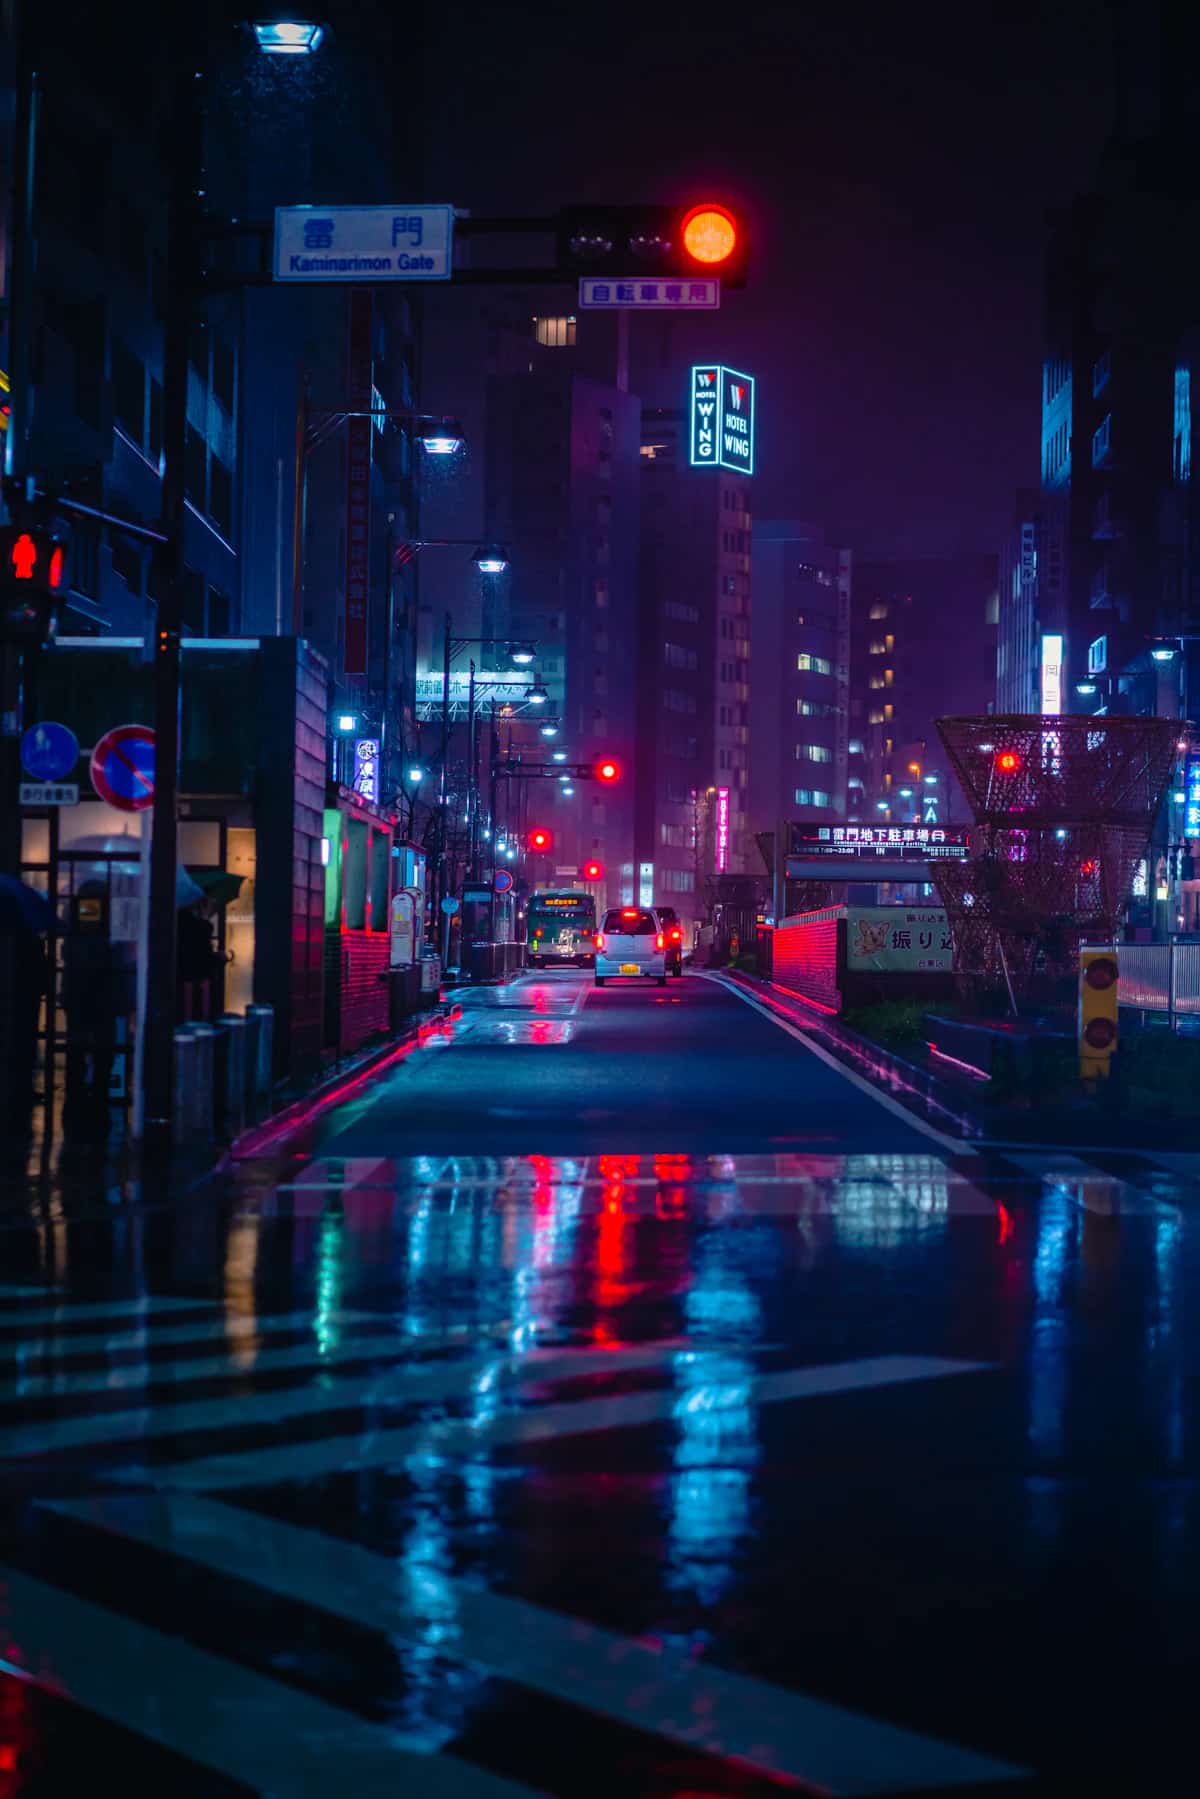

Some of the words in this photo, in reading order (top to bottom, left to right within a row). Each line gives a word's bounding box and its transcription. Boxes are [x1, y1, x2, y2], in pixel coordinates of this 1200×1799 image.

[290, 254, 391, 272] Kaminarimon
[398, 253, 435, 271] Gate
[697, 402, 715, 457] WING
[725, 413, 748, 434] HOTEL
[724, 434, 749, 458] WING
